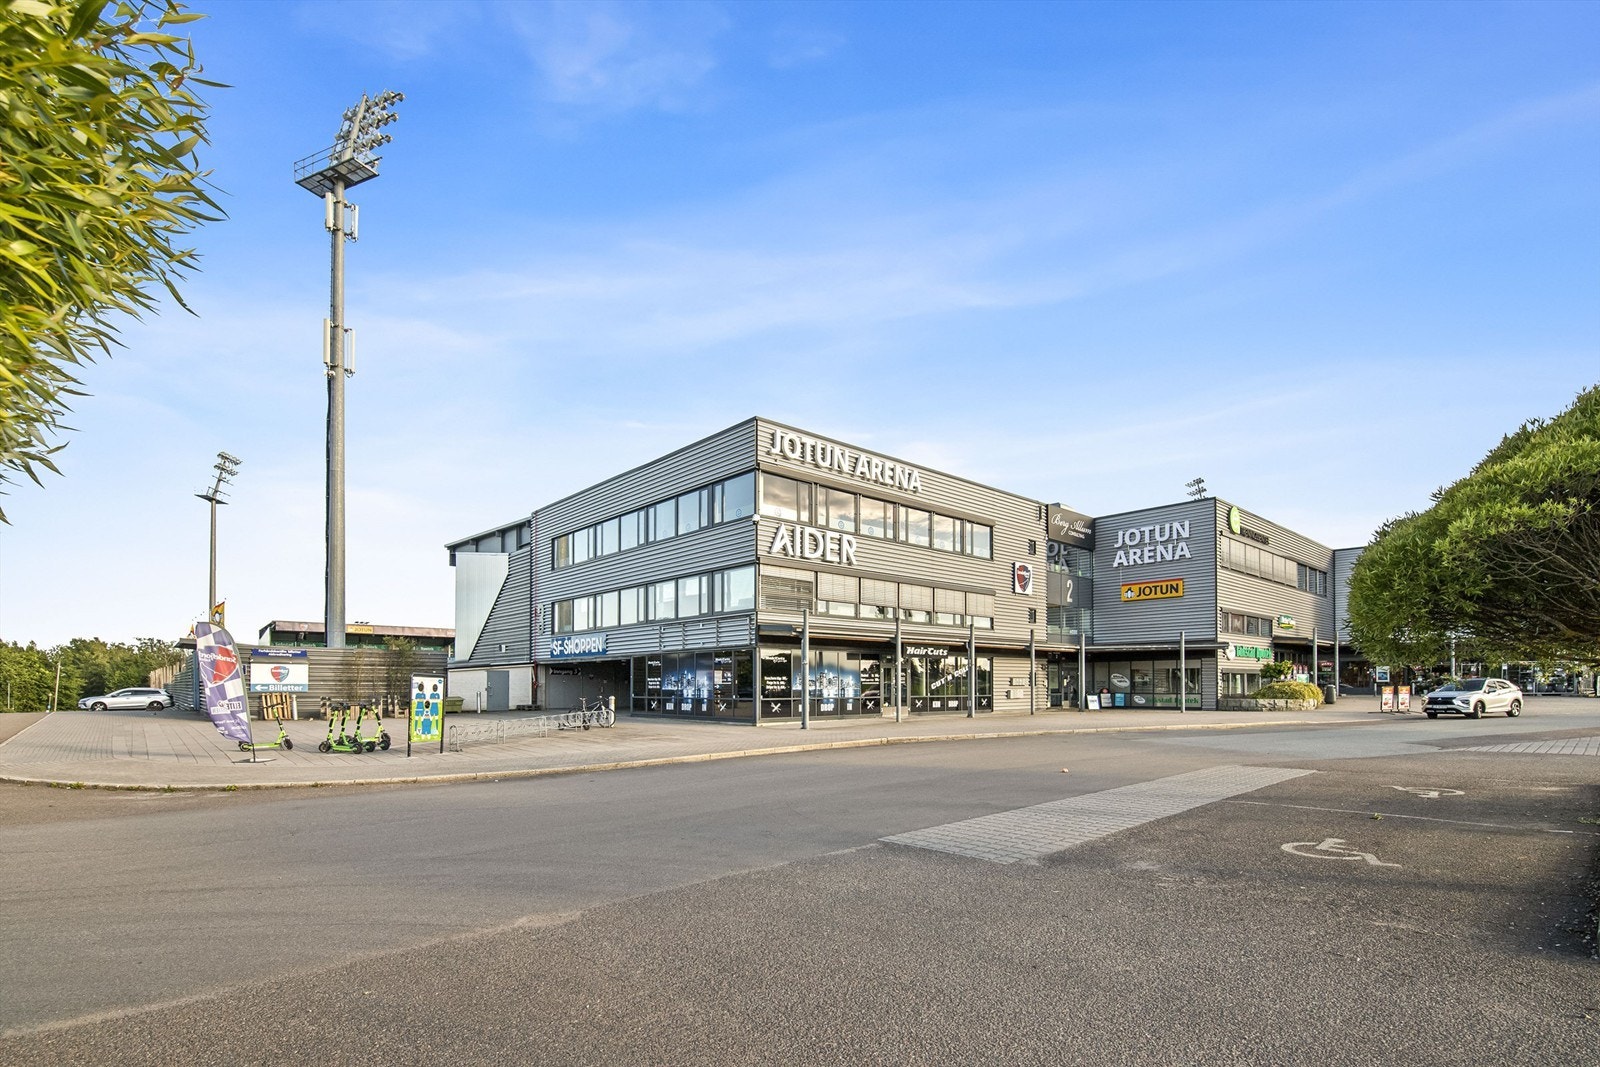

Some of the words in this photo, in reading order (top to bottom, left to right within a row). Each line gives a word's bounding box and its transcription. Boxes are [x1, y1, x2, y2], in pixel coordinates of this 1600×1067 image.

[769, 428, 853, 474] JOTUN
[854, 454, 922, 493] ARENA
[1051, 513, 1070, 535] Berg
[1113, 520, 1190, 549] JOTUN
[770, 523, 858, 565] AIDER
[1112, 541, 1192, 567] ARENA
[1066, 579, 1074, 603] 2
[1136, 583, 1179, 598] JOTUN
[552, 636, 602, 656] SF-SHOPPEN
[906, 646, 948, 656] HairCuts
